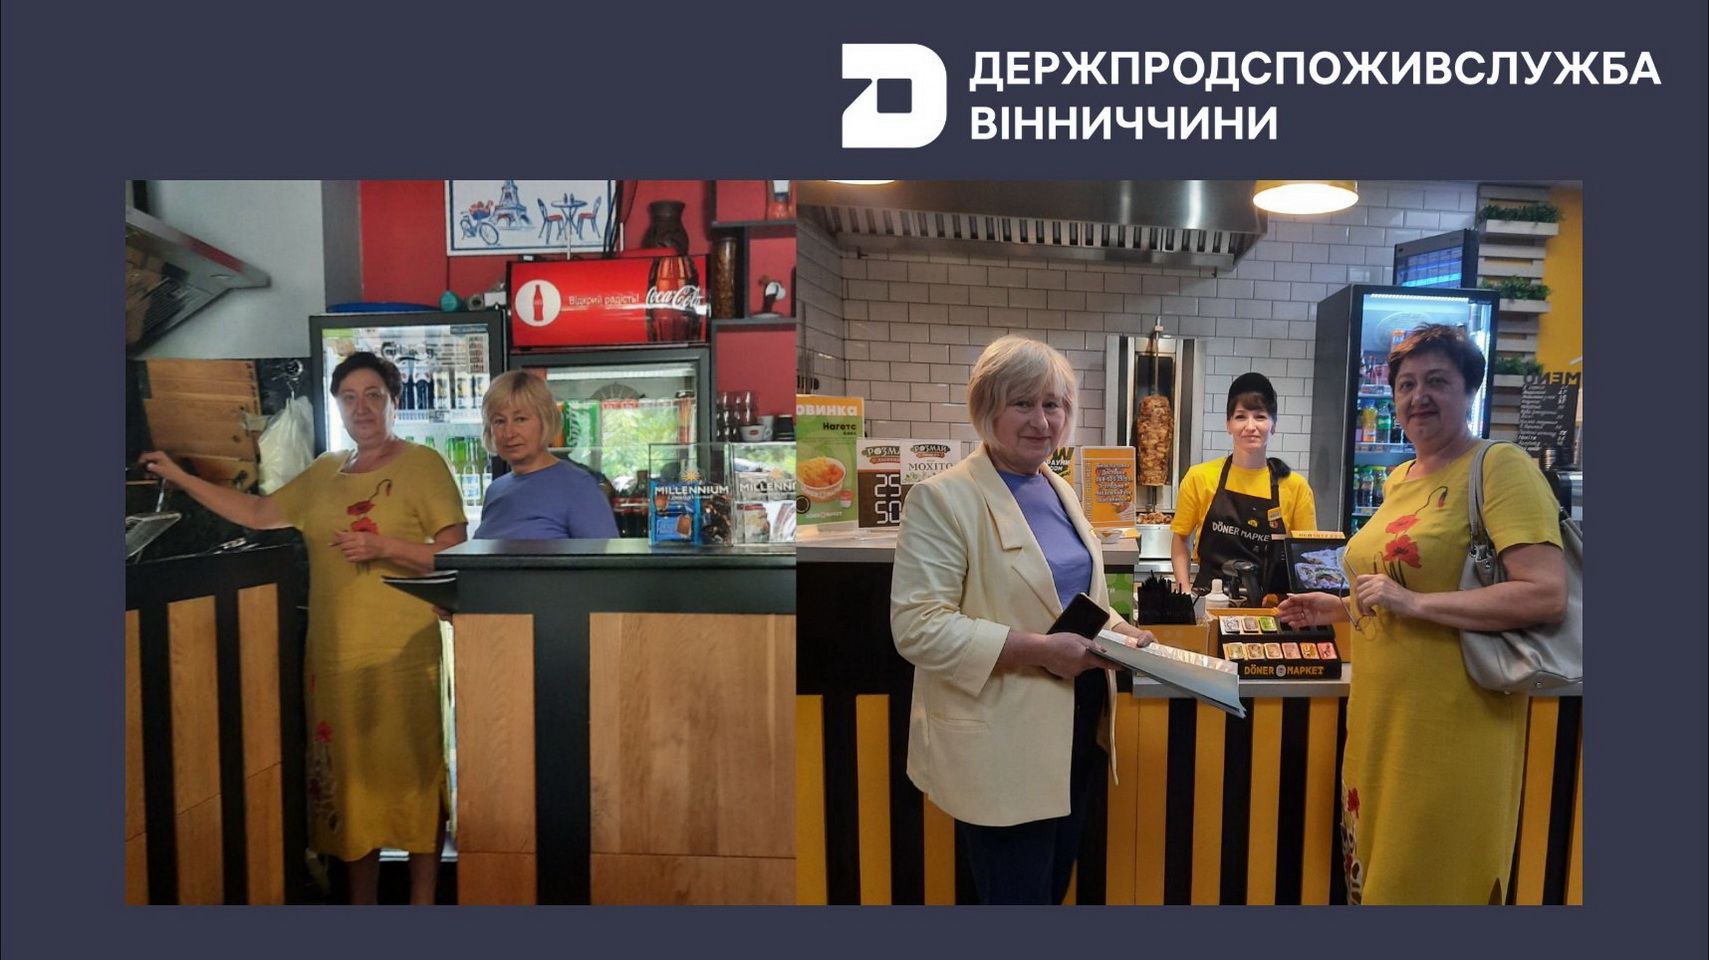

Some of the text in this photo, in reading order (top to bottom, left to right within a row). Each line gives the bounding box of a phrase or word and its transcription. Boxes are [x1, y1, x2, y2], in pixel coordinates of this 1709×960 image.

[823, 422, 857, 431] Нагетс
[654, 485, 729, 495] MILLENNIUM
[1212, 521, 1240, 535] DÖNER
[1244, 664, 1275, 675] DÖNER
